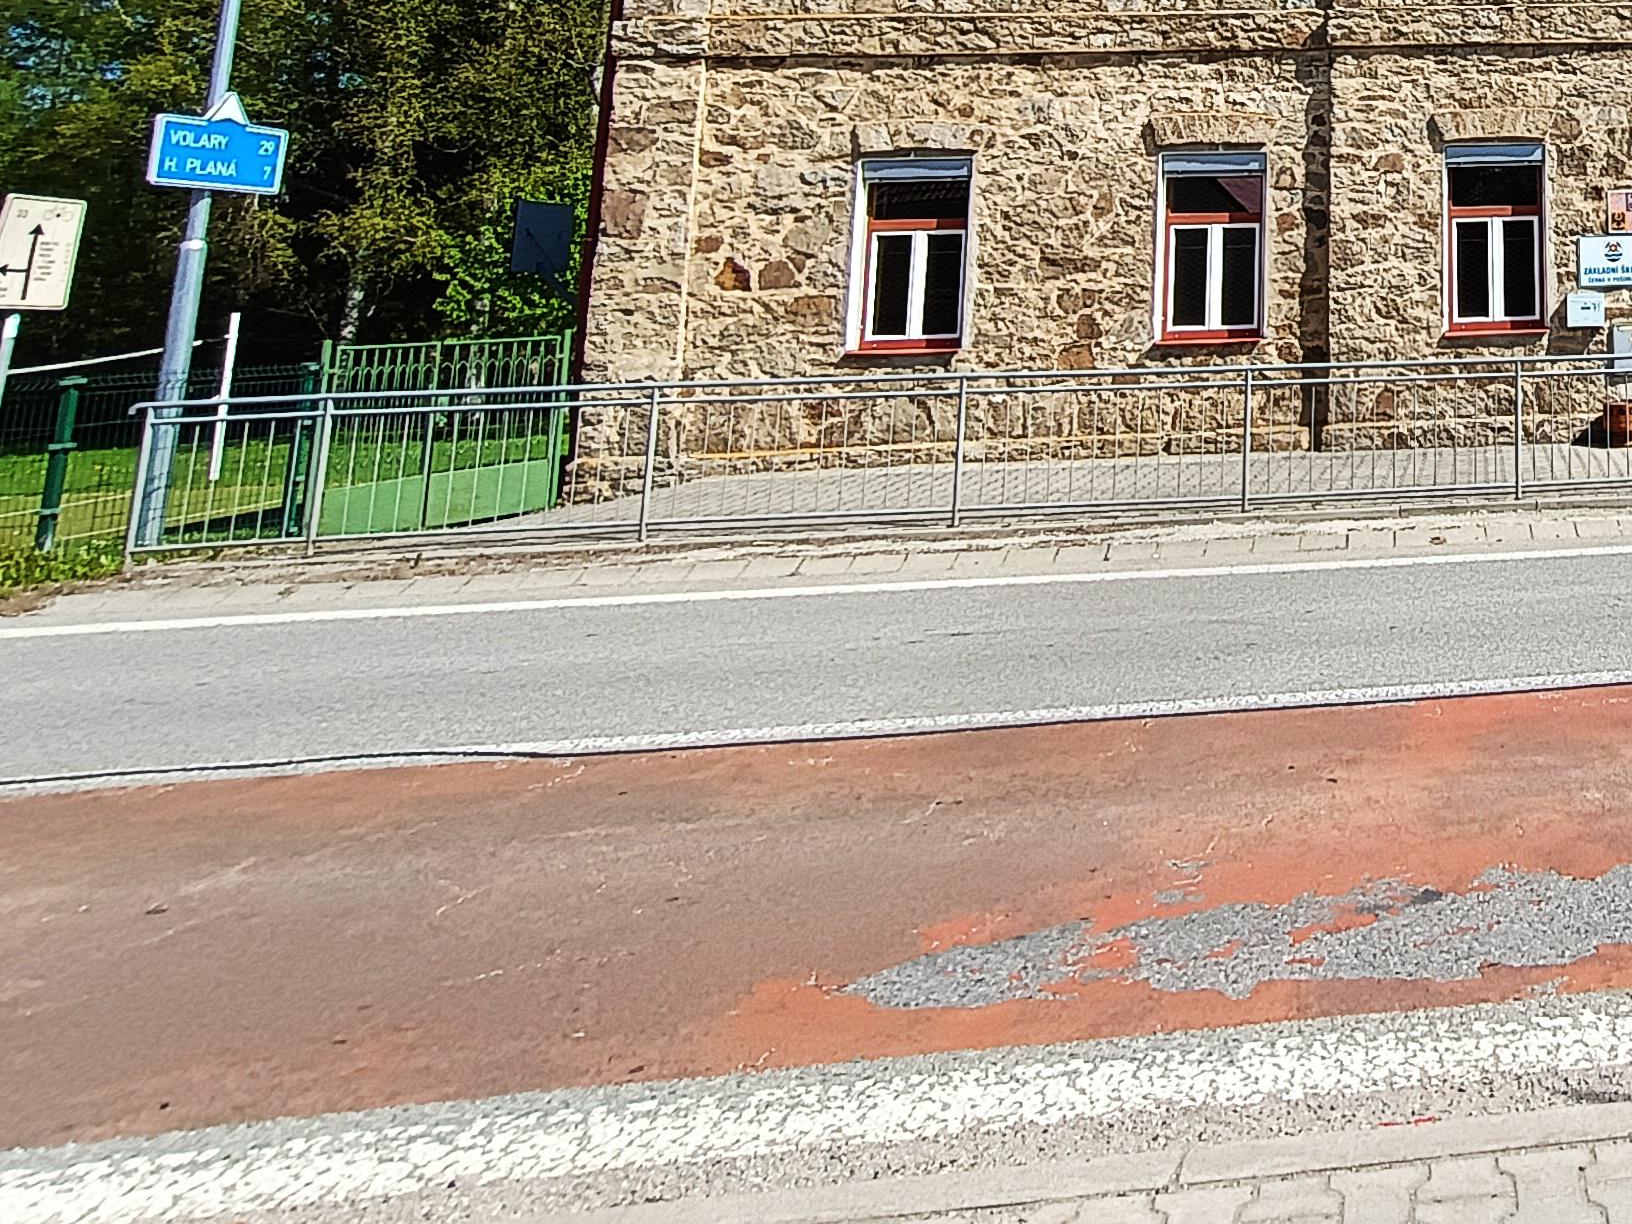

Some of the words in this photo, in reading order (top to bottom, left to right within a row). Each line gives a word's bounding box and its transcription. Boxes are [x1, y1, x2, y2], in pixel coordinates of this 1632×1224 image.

[169, 129, 229, 150] VOLARY
[257, 140, 275, 156] 29
[163, 155, 177, 172] H.
[185, 158, 237, 178] PLANÁ
[262, 165, 273, 180] 7
[1584, 265, 1618, 275] ZÁKLADNÍ
